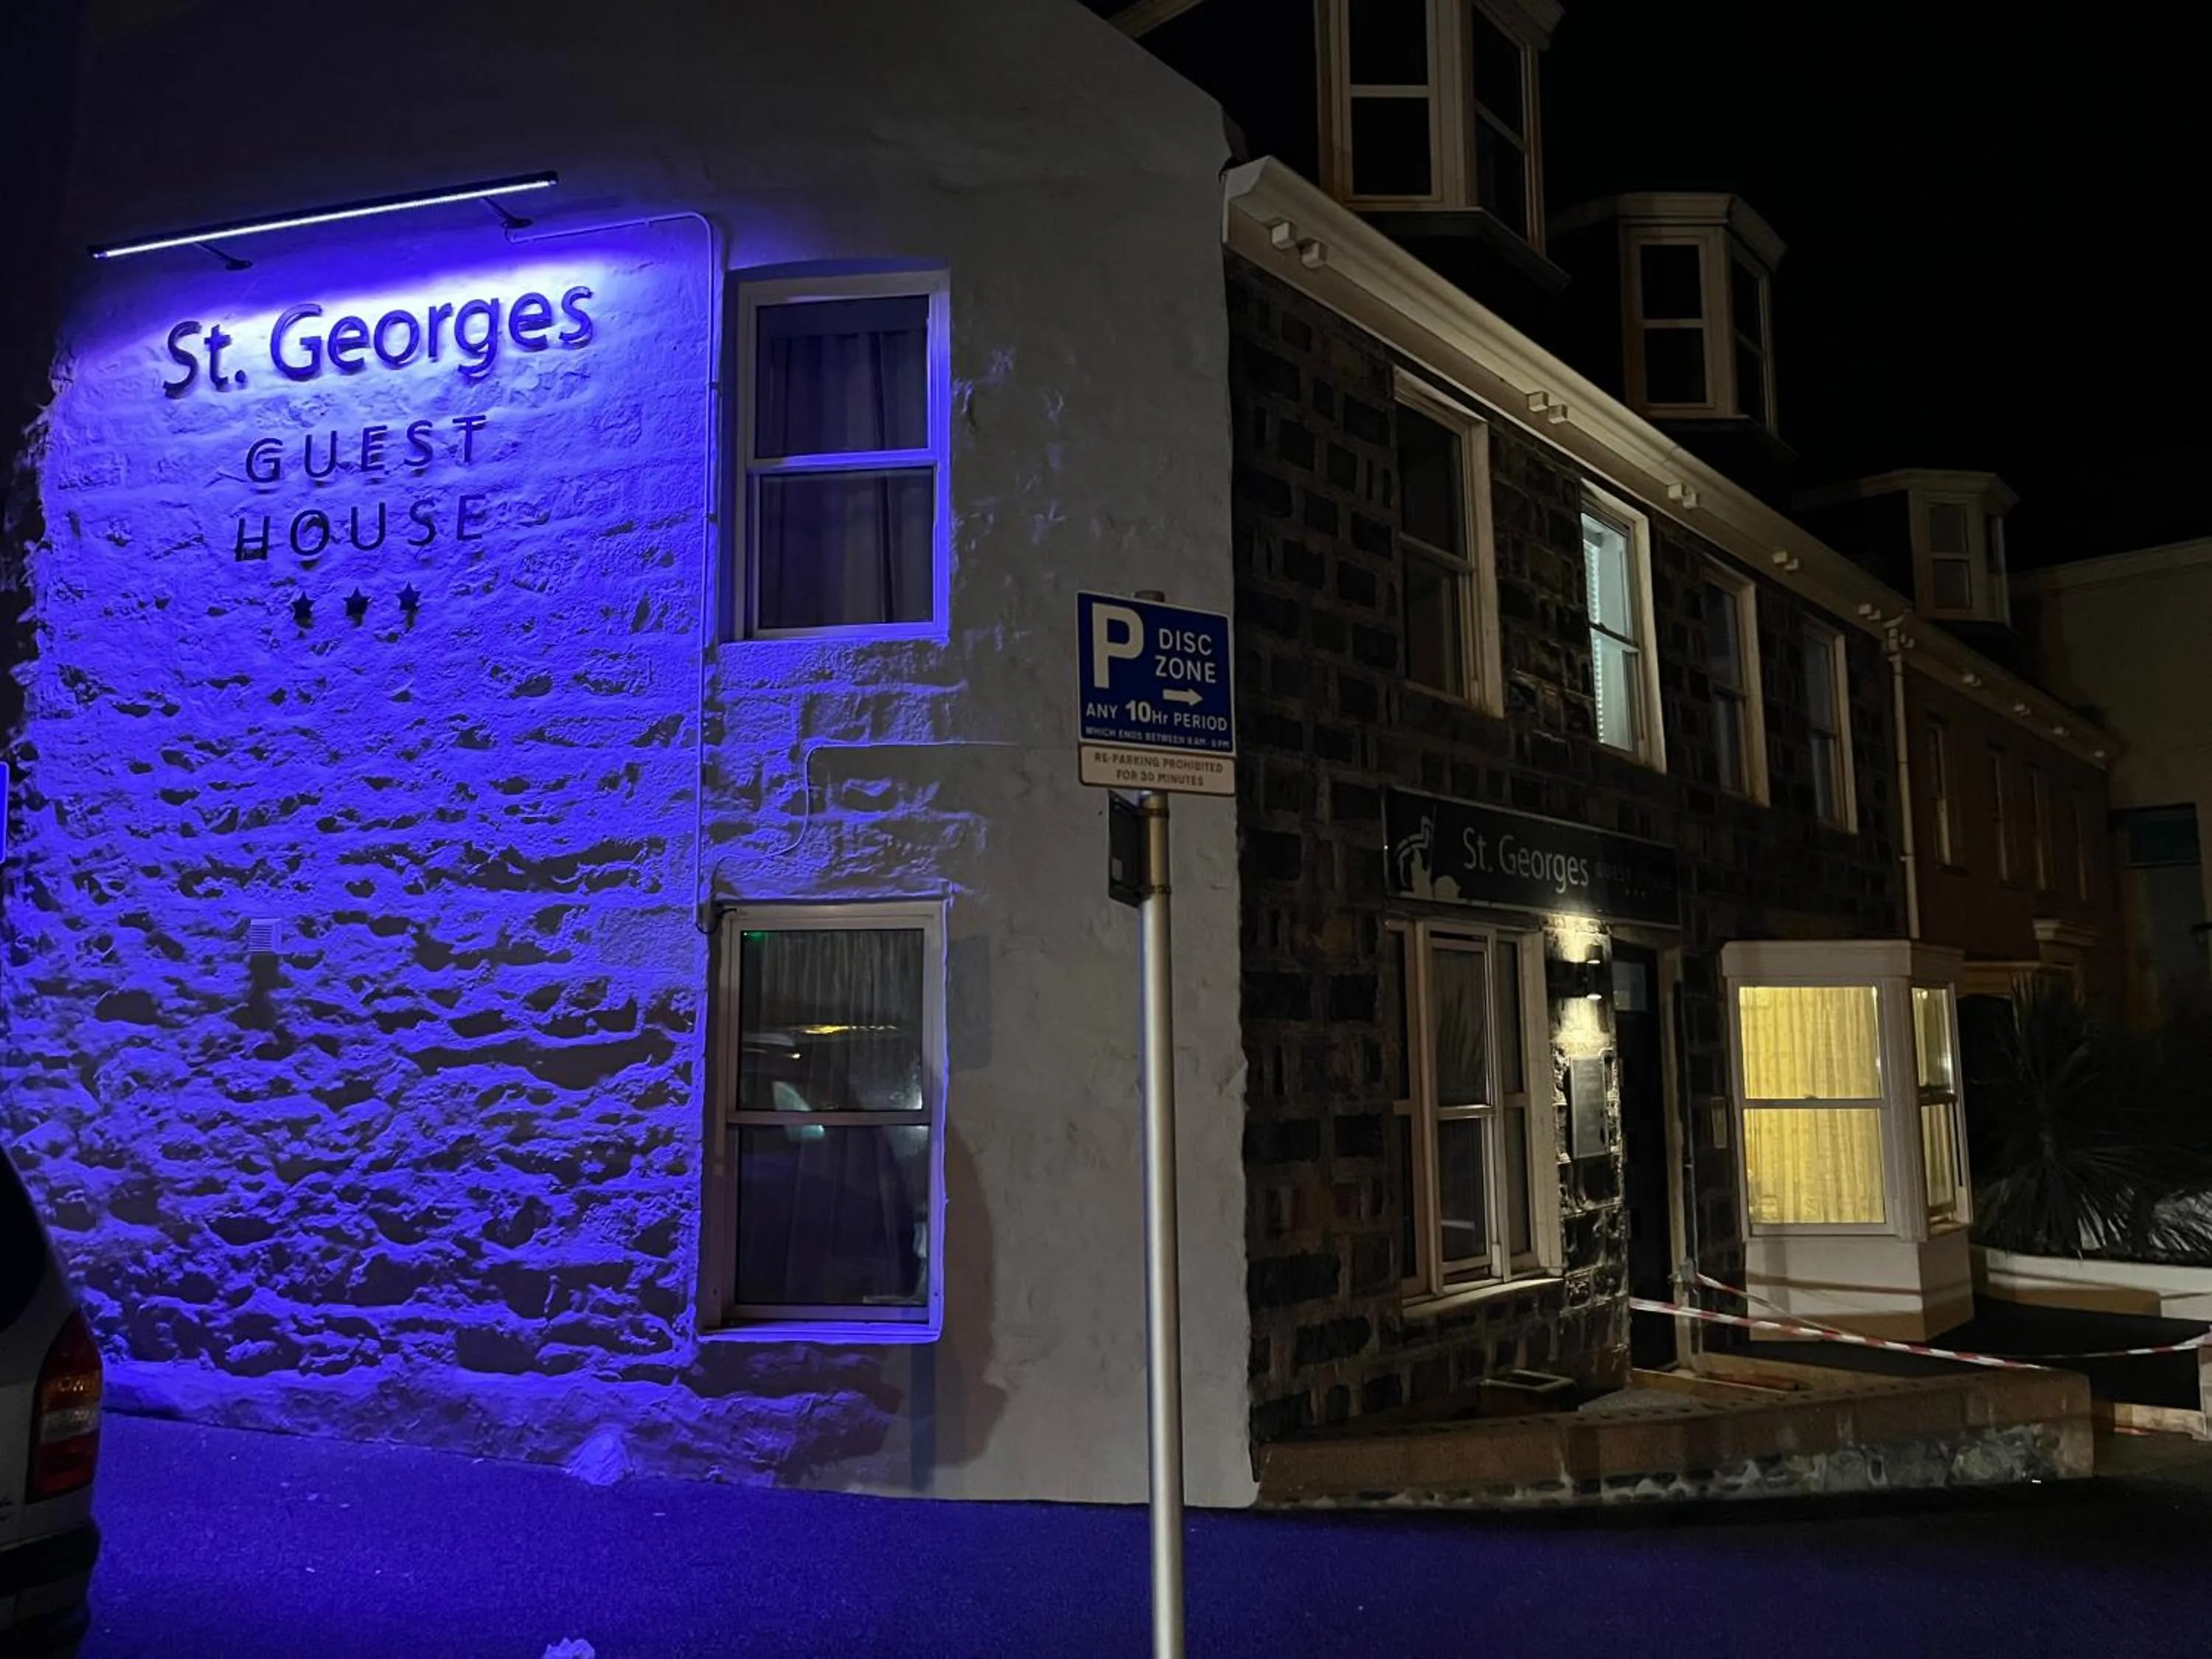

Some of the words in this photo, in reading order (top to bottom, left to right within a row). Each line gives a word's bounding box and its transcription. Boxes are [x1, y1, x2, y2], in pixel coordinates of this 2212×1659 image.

[162, 320, 249, 399] St.
[269, 285, 594, 381] Georges
[245, 415, 487, 483] GUEST
[234, 494, 487, 562] HOUSE
[1092, 602, 1144, 689] P
[1158, 627, 1213, 655] DISC
[1155, 655, 1217, 683] ZONE
[1085, 703, 1118, 720] ANY
[1174, 712, 1228, 731] PERIOD
[1116, 768, 1138, 780] FOR
[1158, 773, 1205, 787] MINUTES
[1163, 758, 1224, 773] PROHIBITED
[1498, 834, 1590, 894] Georges
